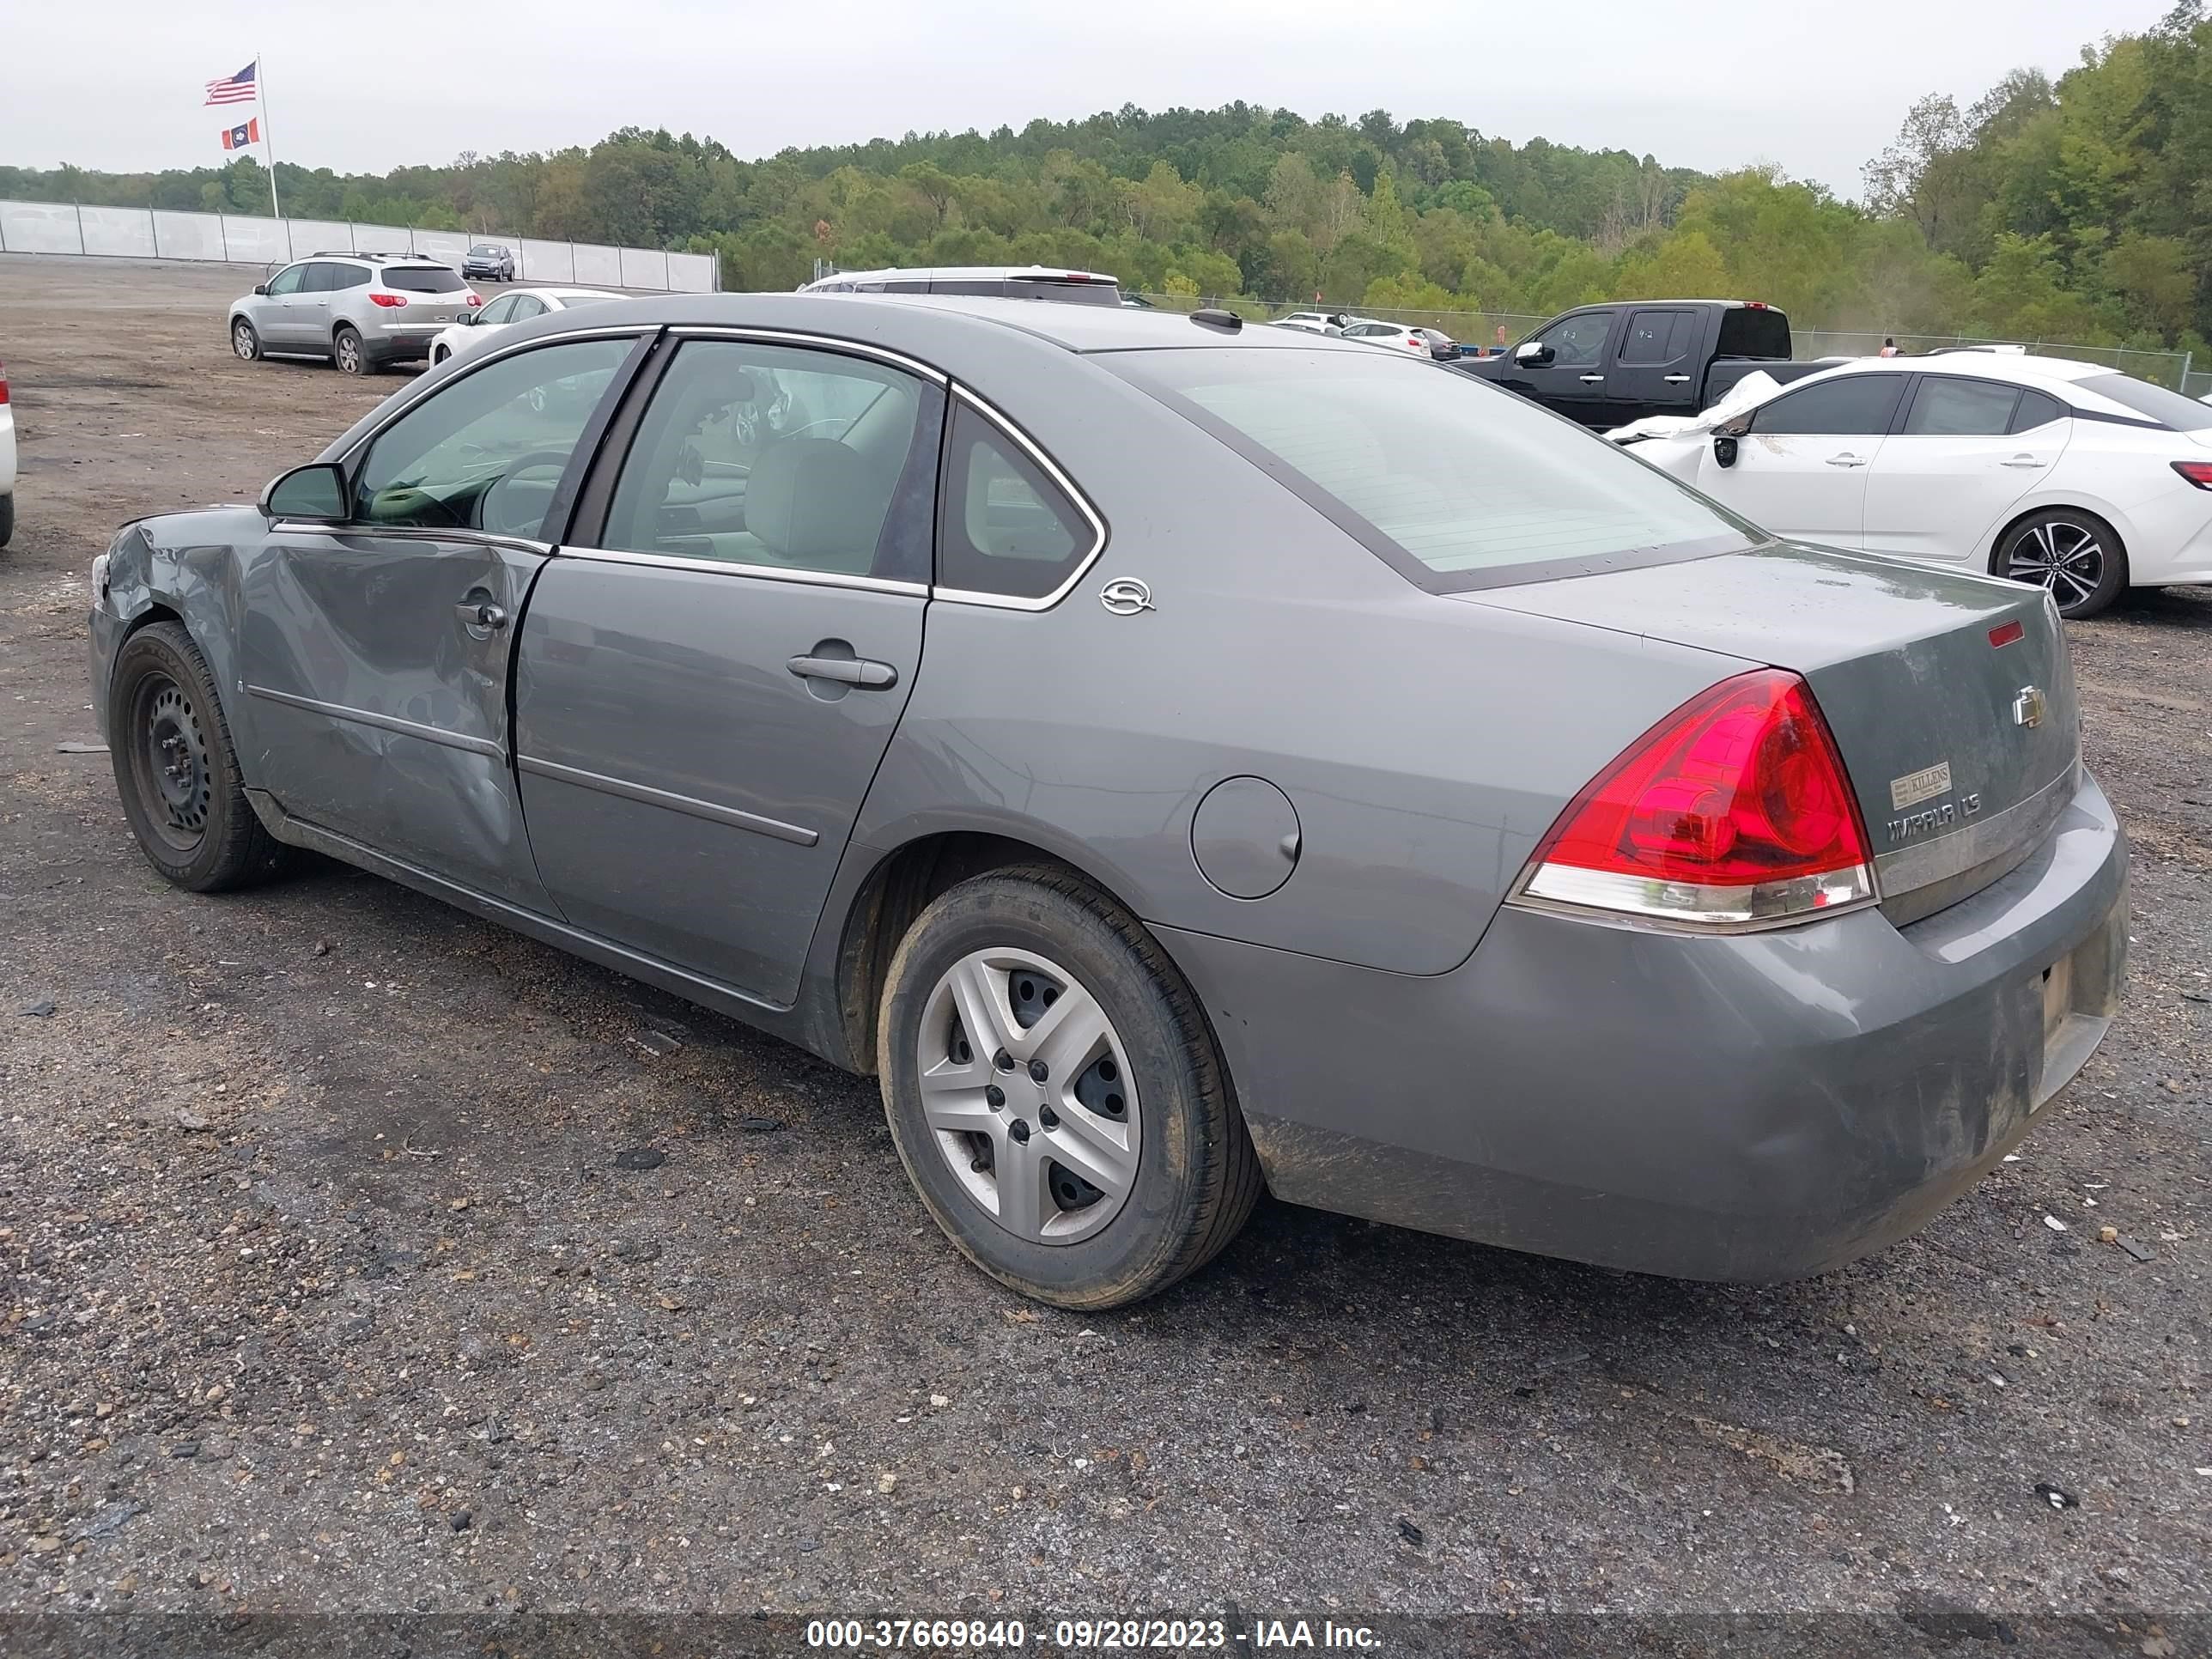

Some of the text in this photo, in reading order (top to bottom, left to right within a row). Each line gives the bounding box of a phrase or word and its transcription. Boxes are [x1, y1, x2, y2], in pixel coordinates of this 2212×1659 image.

[1911, 768, 1948, 792] KILLENS
[1887, 793, 1981, 842] IMPALA LS
